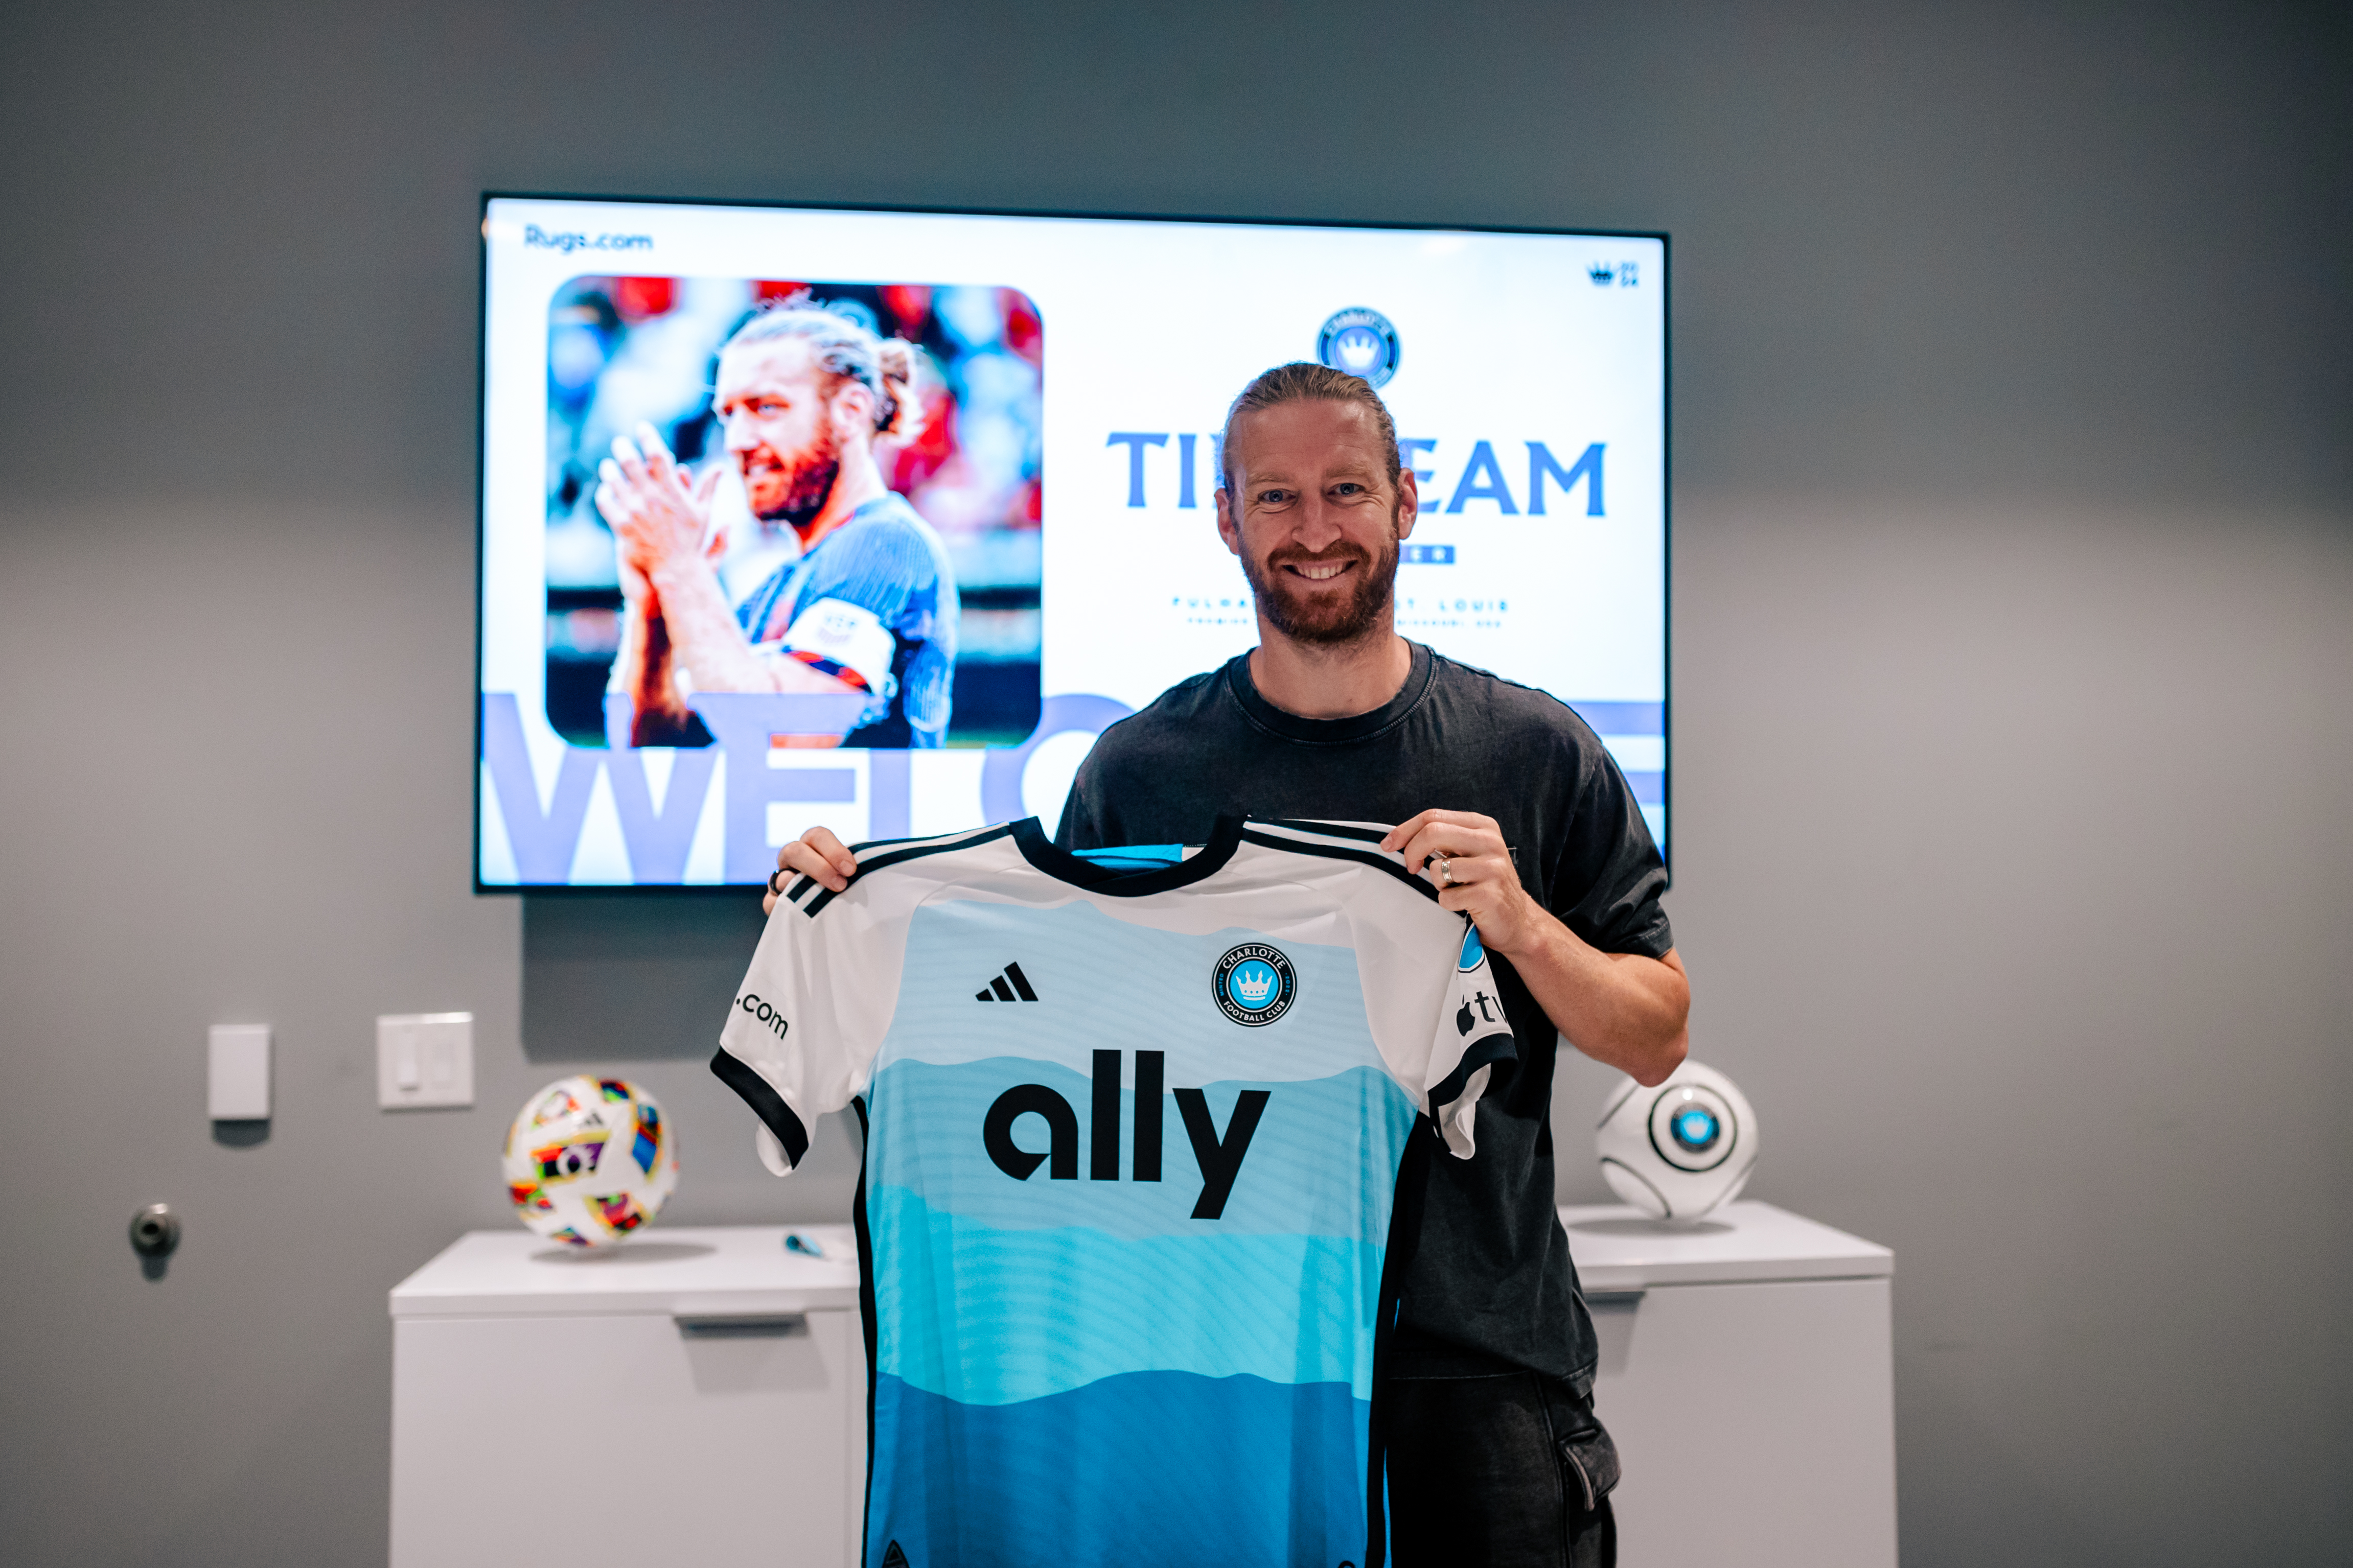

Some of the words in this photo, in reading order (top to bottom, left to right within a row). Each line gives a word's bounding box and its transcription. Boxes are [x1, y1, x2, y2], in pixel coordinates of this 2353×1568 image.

[524, 223, 654, 255] Rugs.com
[1105, 432, 1226, 509] TI
[1398, 438, 1607, 517] EAM
[1222, 947, 1286, 969] CHARLOTTE
[1224, 1000, 1265, 1021] FOOTBALL
[1266, 1000, 1285, 1018] CLUB
[983, 1049, 1272, 1220] ally
